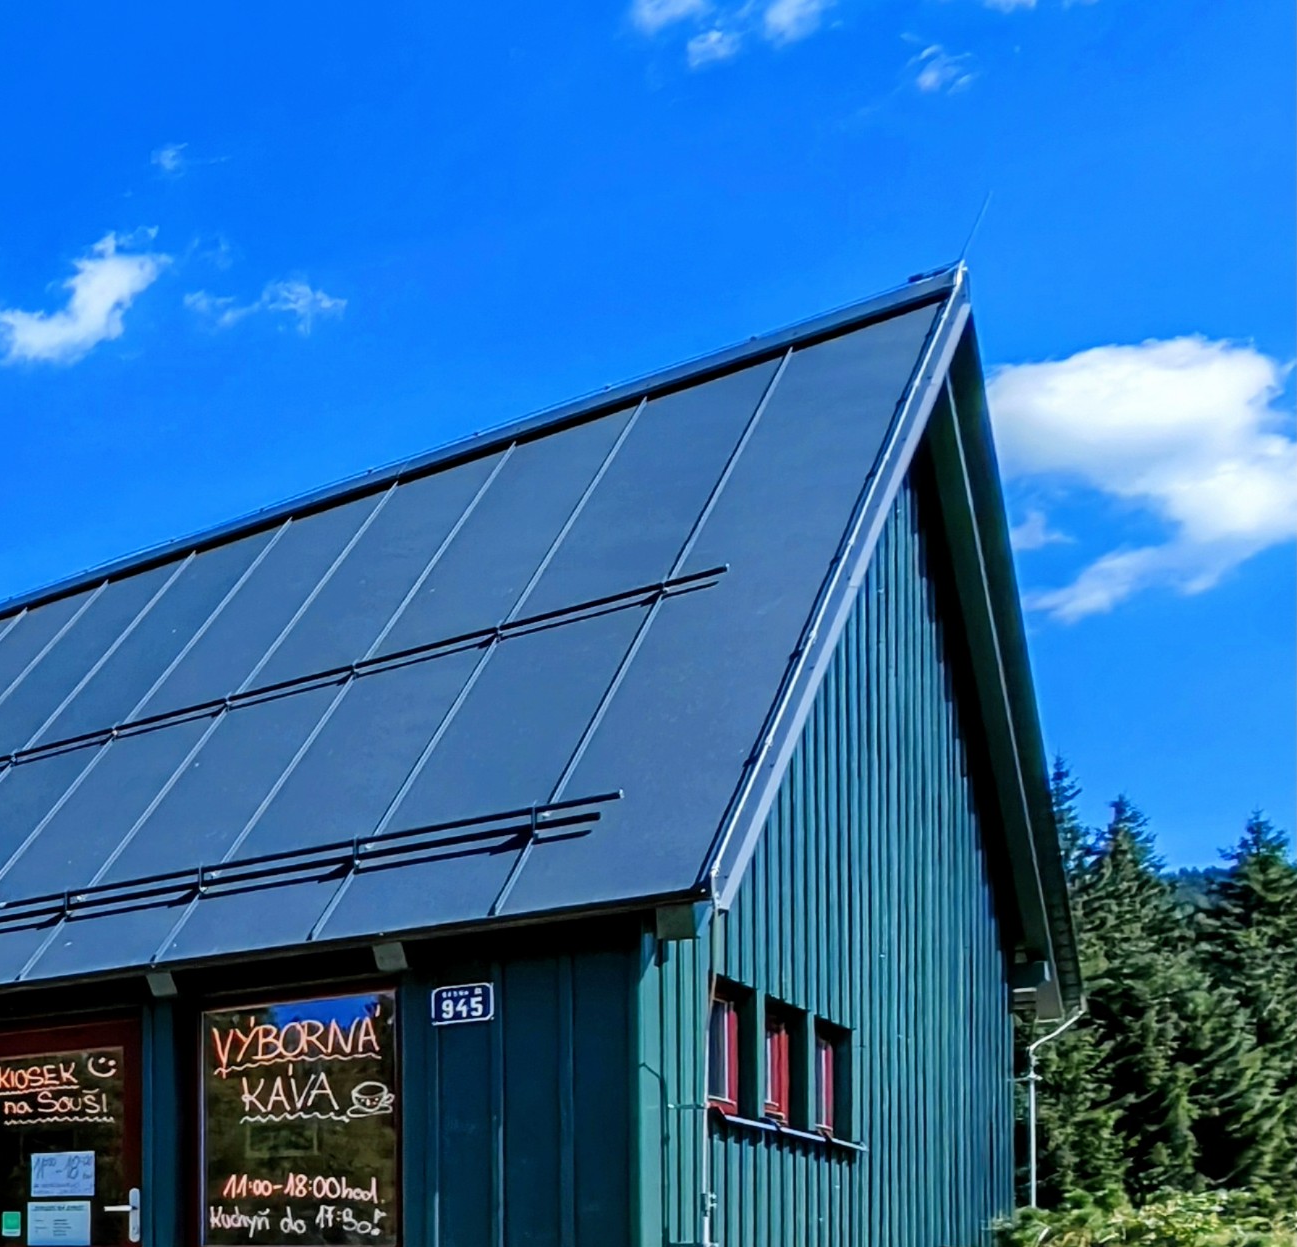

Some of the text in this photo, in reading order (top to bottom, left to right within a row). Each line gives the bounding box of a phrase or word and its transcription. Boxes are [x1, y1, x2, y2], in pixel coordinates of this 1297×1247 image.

[442, 996, 483, 1019] 945
[212, 1004, 381, 1077] VÝBORNÁ
[241, 1064, 339, 1113] KÁVA
[4, 1101, 33, 1115] na
[280, 1206, 306, 1234] do
